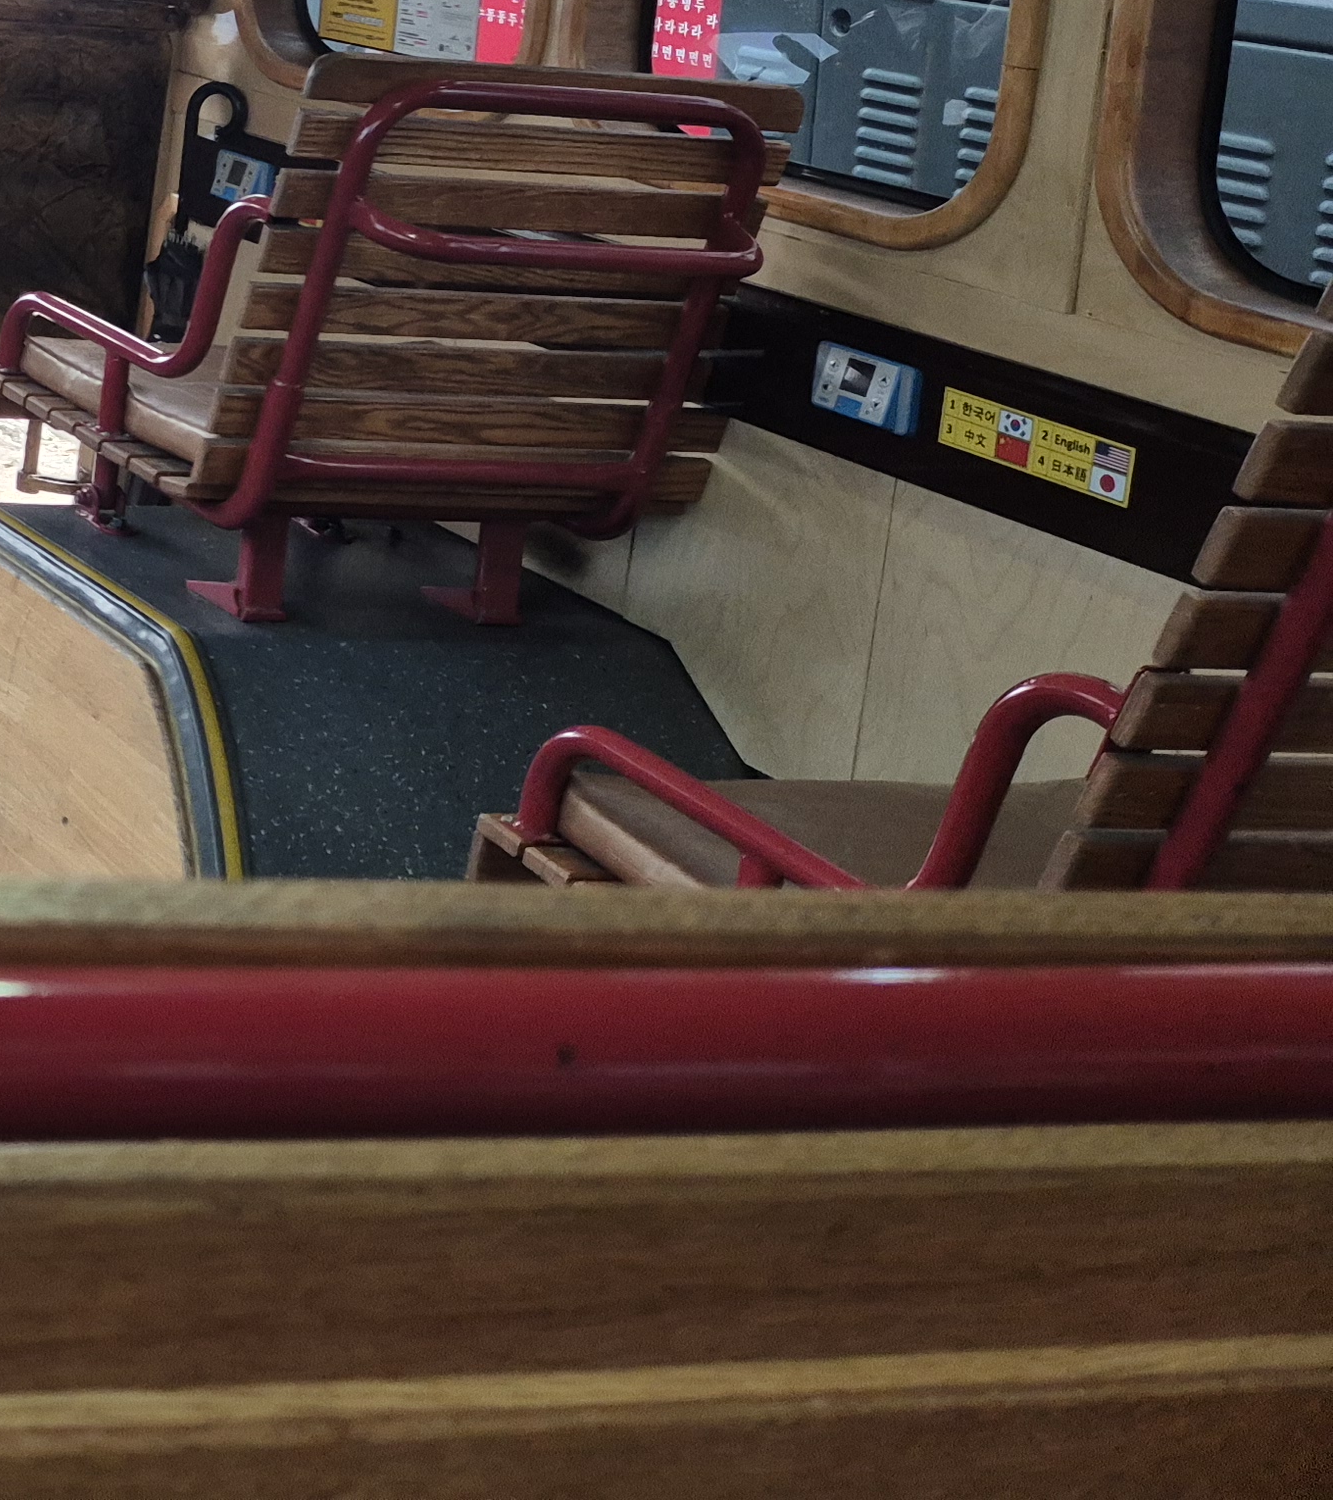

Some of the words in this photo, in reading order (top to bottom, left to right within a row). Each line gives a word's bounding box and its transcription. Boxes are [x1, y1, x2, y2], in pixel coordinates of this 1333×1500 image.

[962, 401, 996, 425] 한국어
[964, 428, 987, 449] 中文
[1054, 433, 1091, 456] English
[1050, 458, 1087, 483] 日本語
